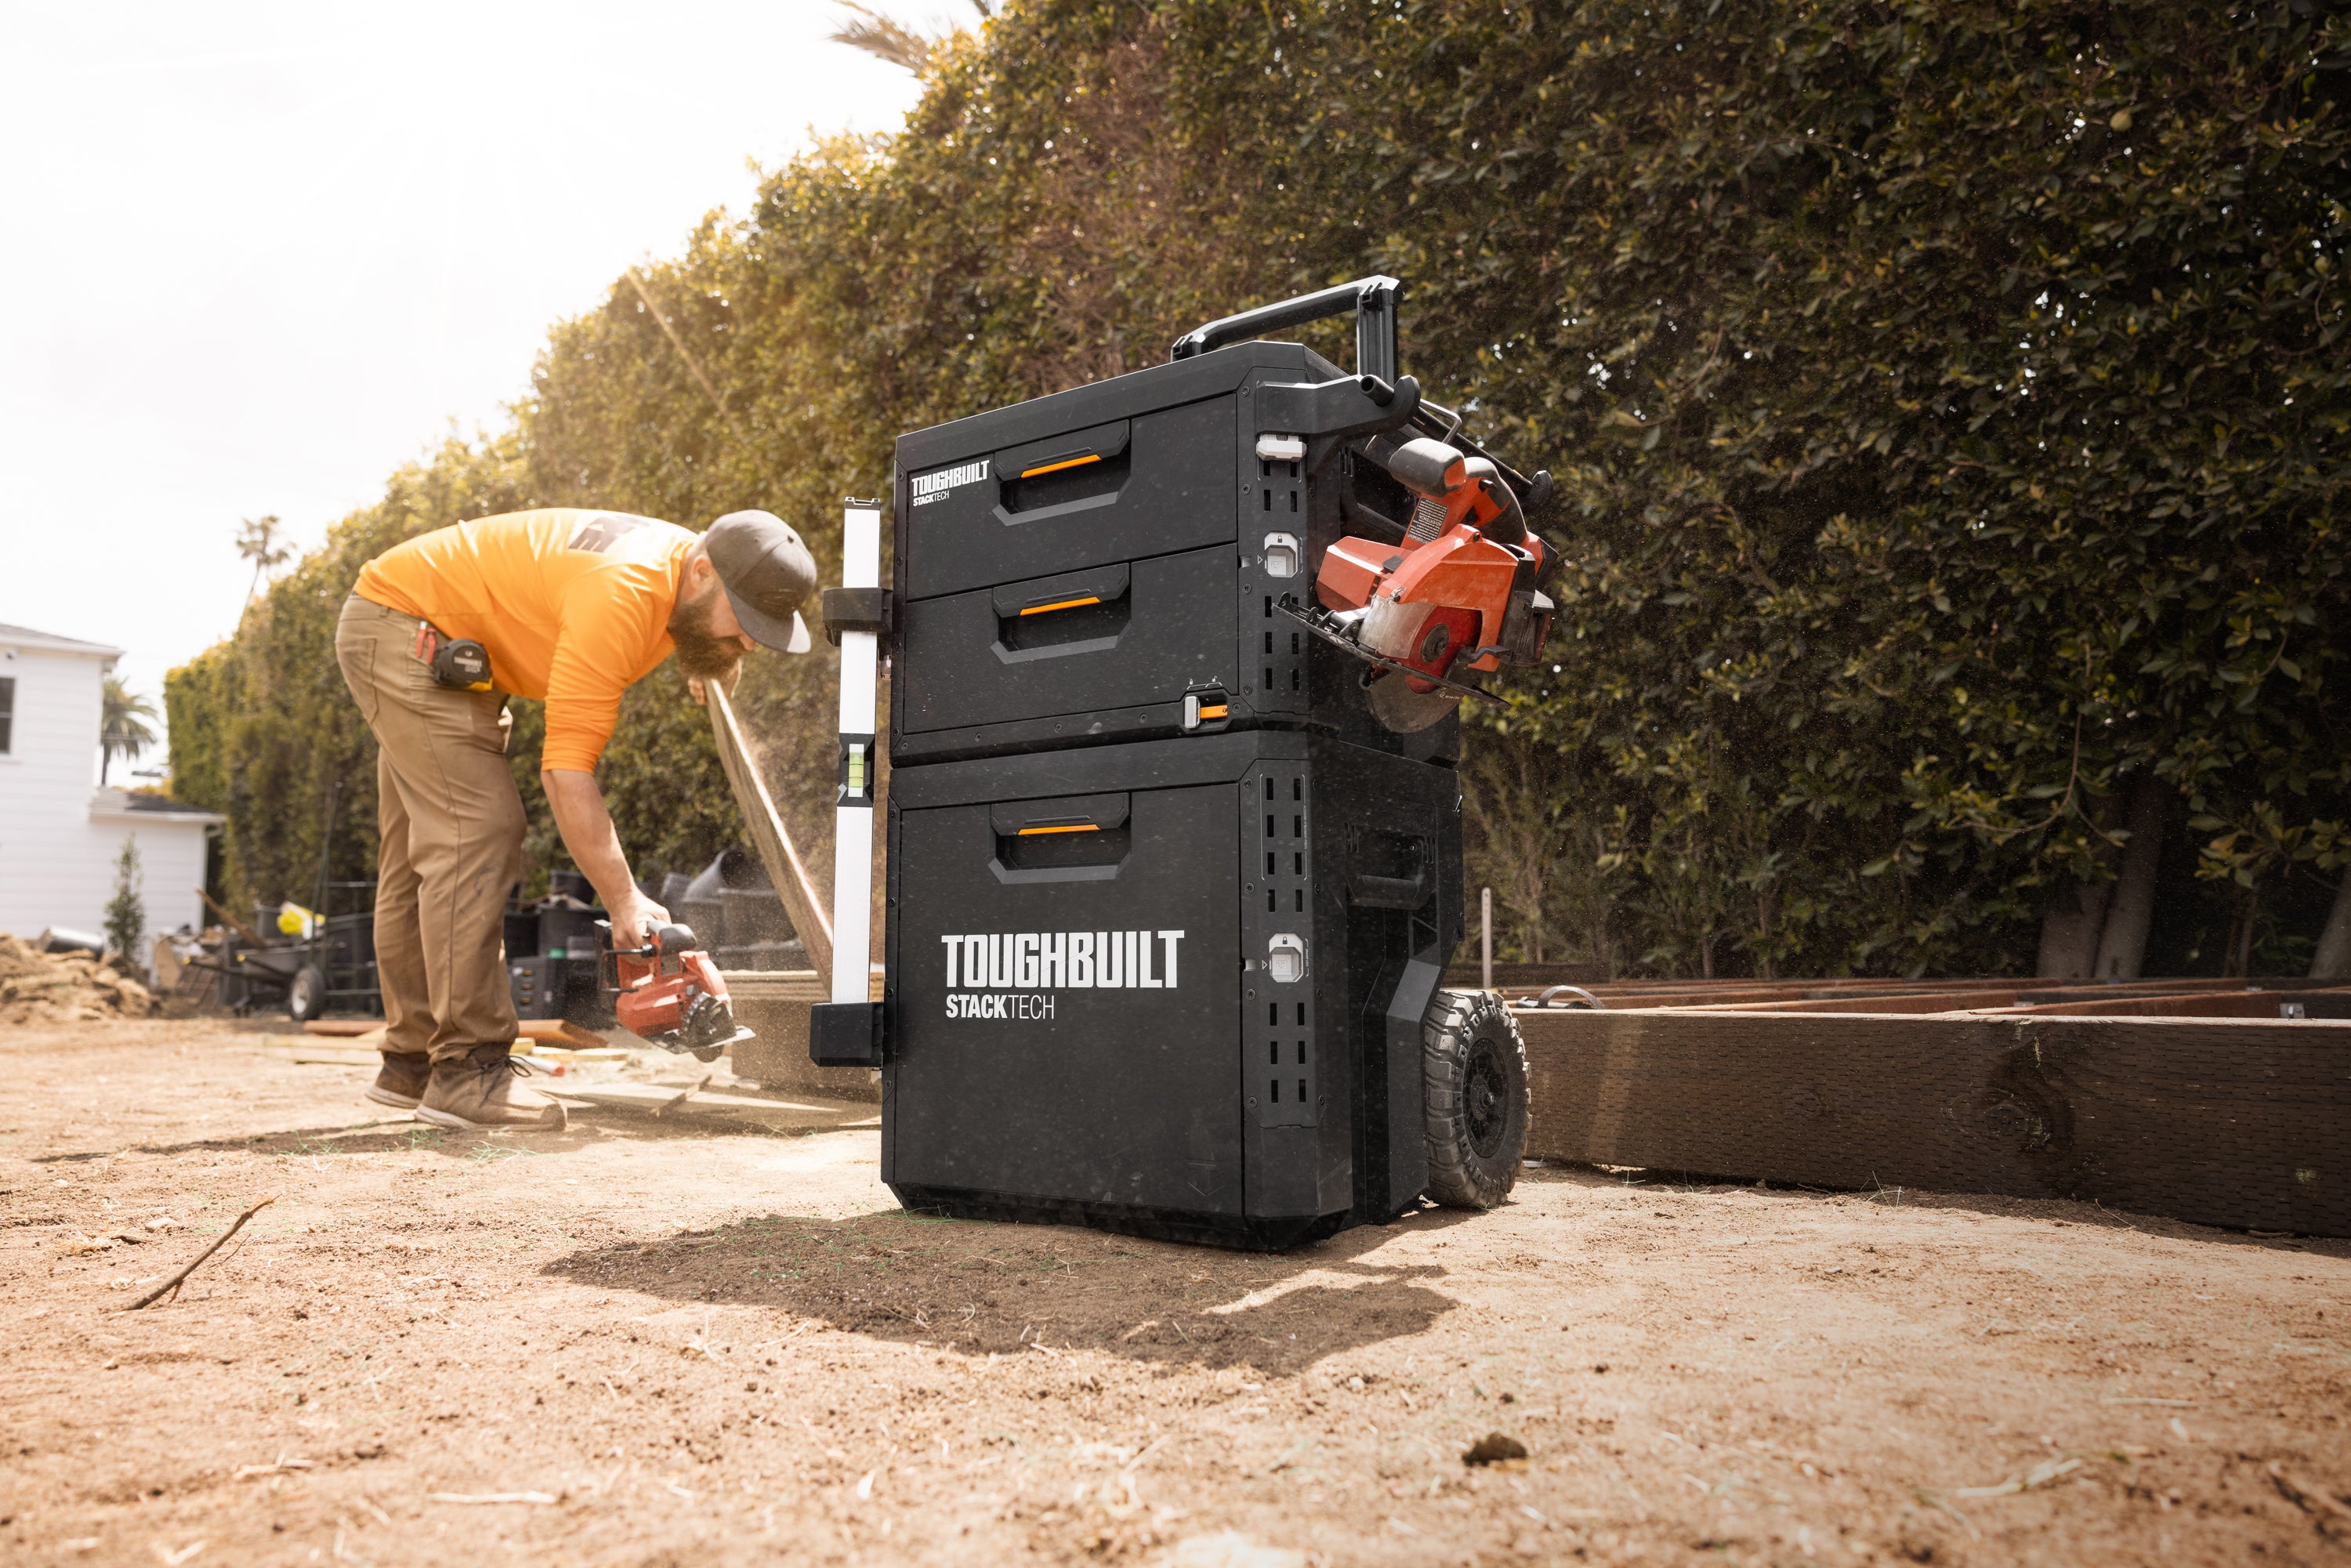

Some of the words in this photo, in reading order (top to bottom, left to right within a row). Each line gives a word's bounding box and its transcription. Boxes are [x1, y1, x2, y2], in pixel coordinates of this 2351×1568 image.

[911, 460, 990, 497] TOUGHBUILT
[913, 490, 950, 507] STACKTECH
[941, 930, 1185, 988] TOUGHBUILT
[946, 994, 1054, 1019] STACKTECH
